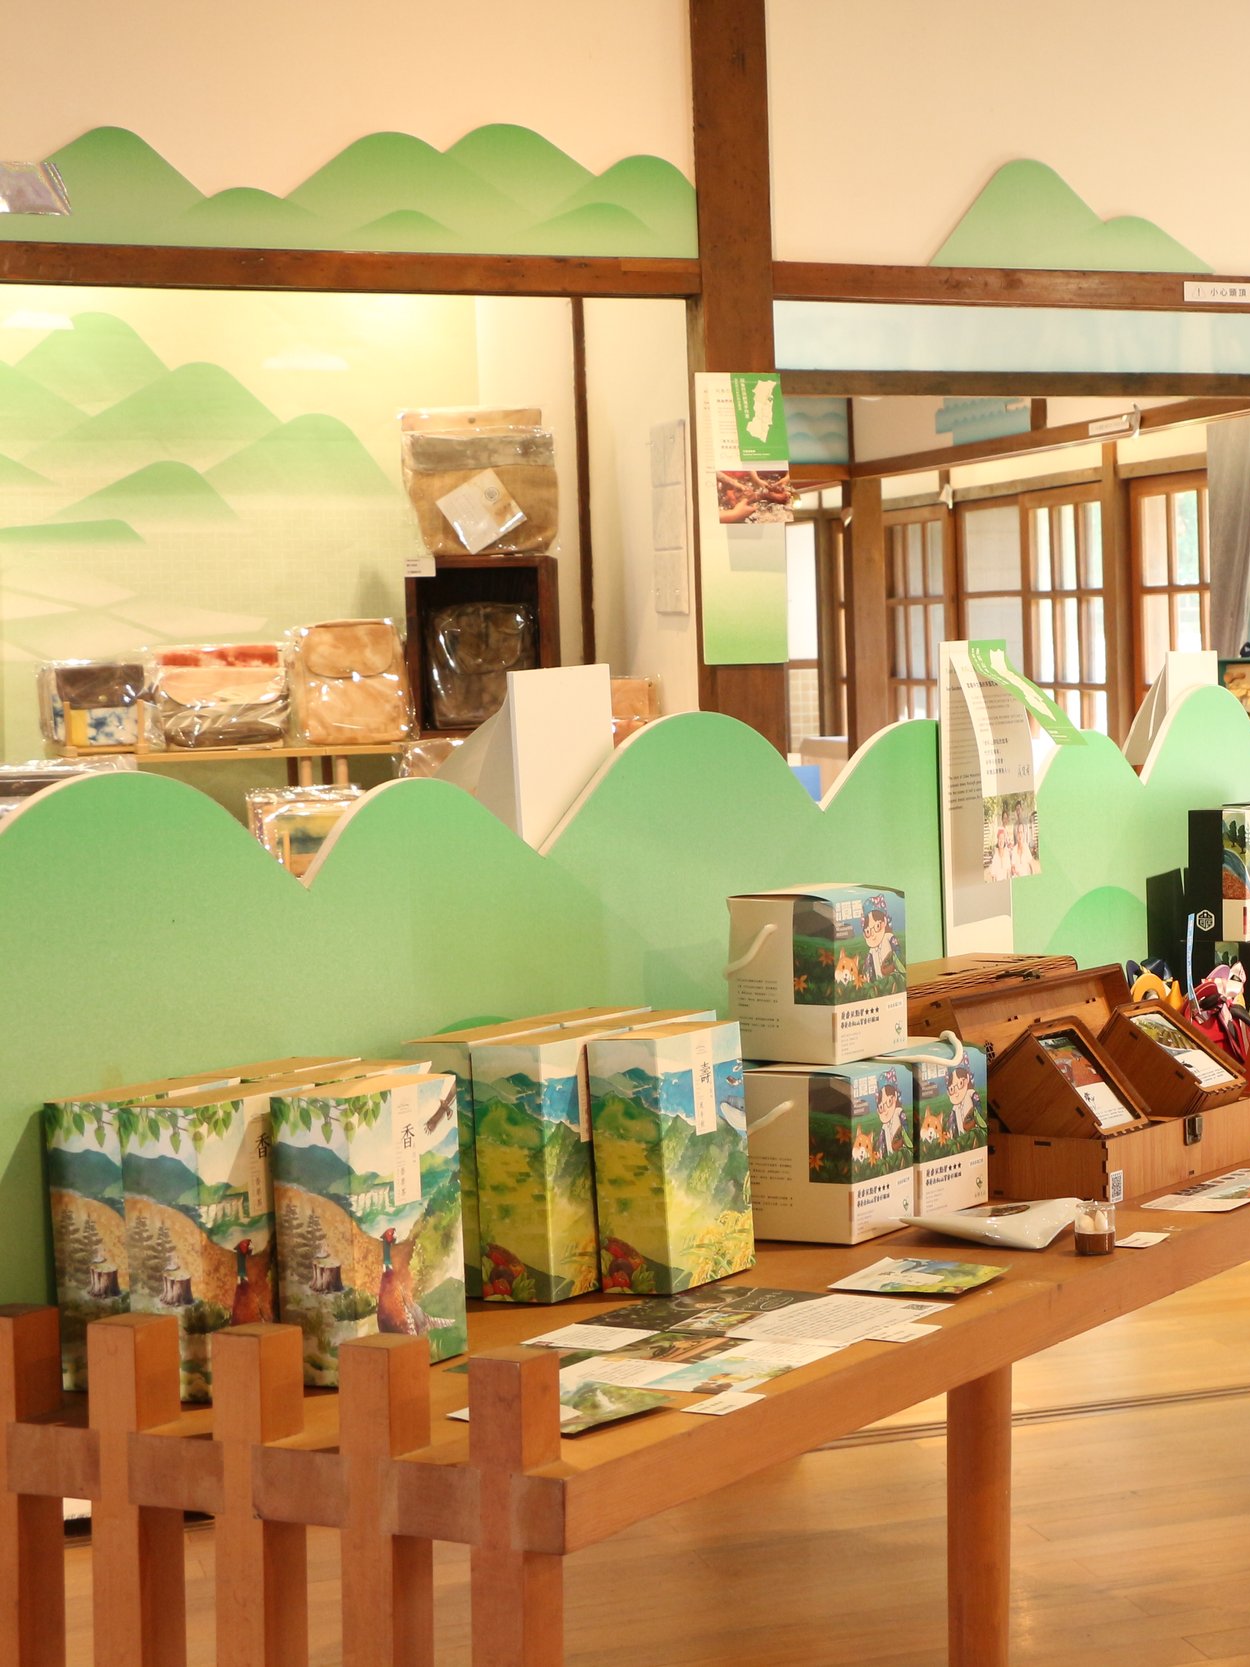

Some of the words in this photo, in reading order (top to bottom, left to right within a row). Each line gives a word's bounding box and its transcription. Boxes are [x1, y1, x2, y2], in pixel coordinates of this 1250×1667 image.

[1210, 287, 1247, 297] 小心頭頂
[255, 1132, 270, 1158] 香
[401, 1123, 415, 1149] 香
